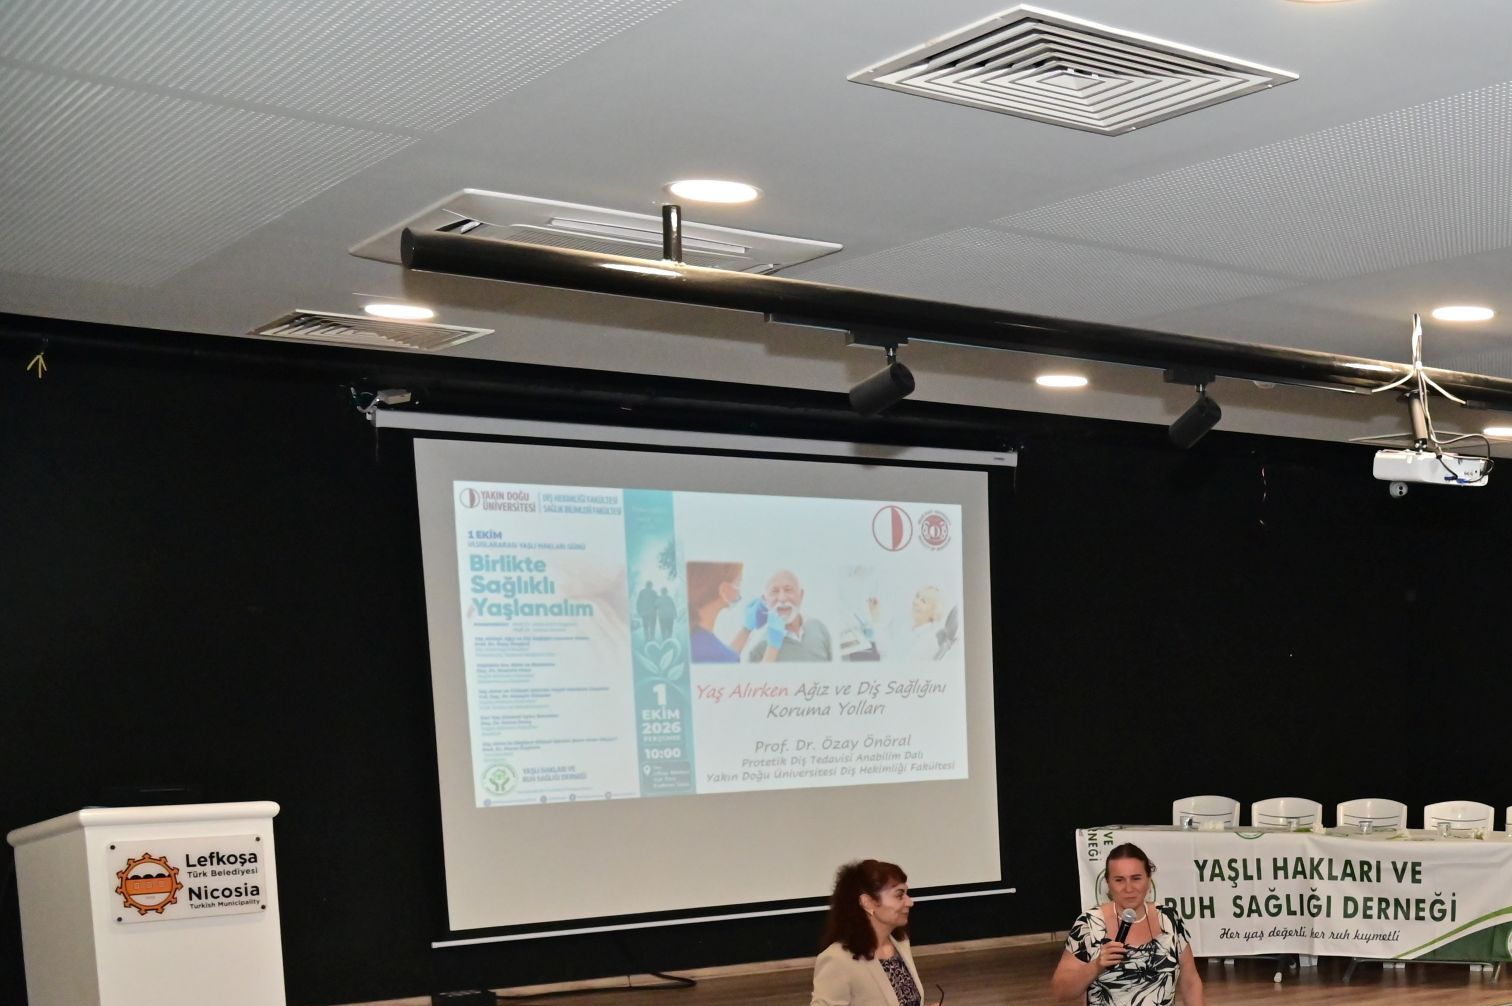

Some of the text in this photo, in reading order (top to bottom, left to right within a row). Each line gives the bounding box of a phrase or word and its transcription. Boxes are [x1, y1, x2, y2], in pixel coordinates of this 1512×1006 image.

[481, 490, 530, 501] YAKIN DOĞU
[482, 501, 536, 512] ÜNİVERSİTESİ
[468, 528, 503, 540] 1 EKİM
[469, 554, 547, 573] Birlikte
[471, 575, 555, 598] Sağlıklı
[472, 598, 594, 621] Yaşlanalım
[652, 683, 668, 706] 1
[697, 678, 947, 704] Yaş Alırken Ağız ve Diş Sağlığını
[641, 705, 681, 720] EKİM
[767, 700, 886, 719] Koruma Yolları
[641, 722, 682, 734] 2026
[755, 733, 913, 754] Prof. Dr. Özay Önöral
[643, 747, 682, 759] 10:00
[741, 757, 788, 768] Protetik
[791, 755, 807, 767] Diş
[811, 753, 853, 765] Tedavisi
[856, 751, 902, 763] Anabilim
[707, 760, 956, 783] Yakın Doğu Üniversitesi Diş Hekimliği Fakültesi
[1103, 831, 1114, 846] VE
[185, 851, 258, 868] Lefkoşa
[187, 867, 258, 879] Türk Belediyesi
[1194, 857, 1423, 888] YAŞLI HAKLARI VE
[188, 882, 260, 901] Nicosia
[189, 899, 260, 910] Turkish Municipality
[1232, 887, 1332, 919] SAĞLIĞI
[1343, 891, 1457, 923] DERNEĞİ
[1219, 927, 1240, 940] Her
[1243, 931, 1265, 942] yaş
[1329, 928, 1351, 941] ruh
[1354, 928, 1401, 944] kıymetli
